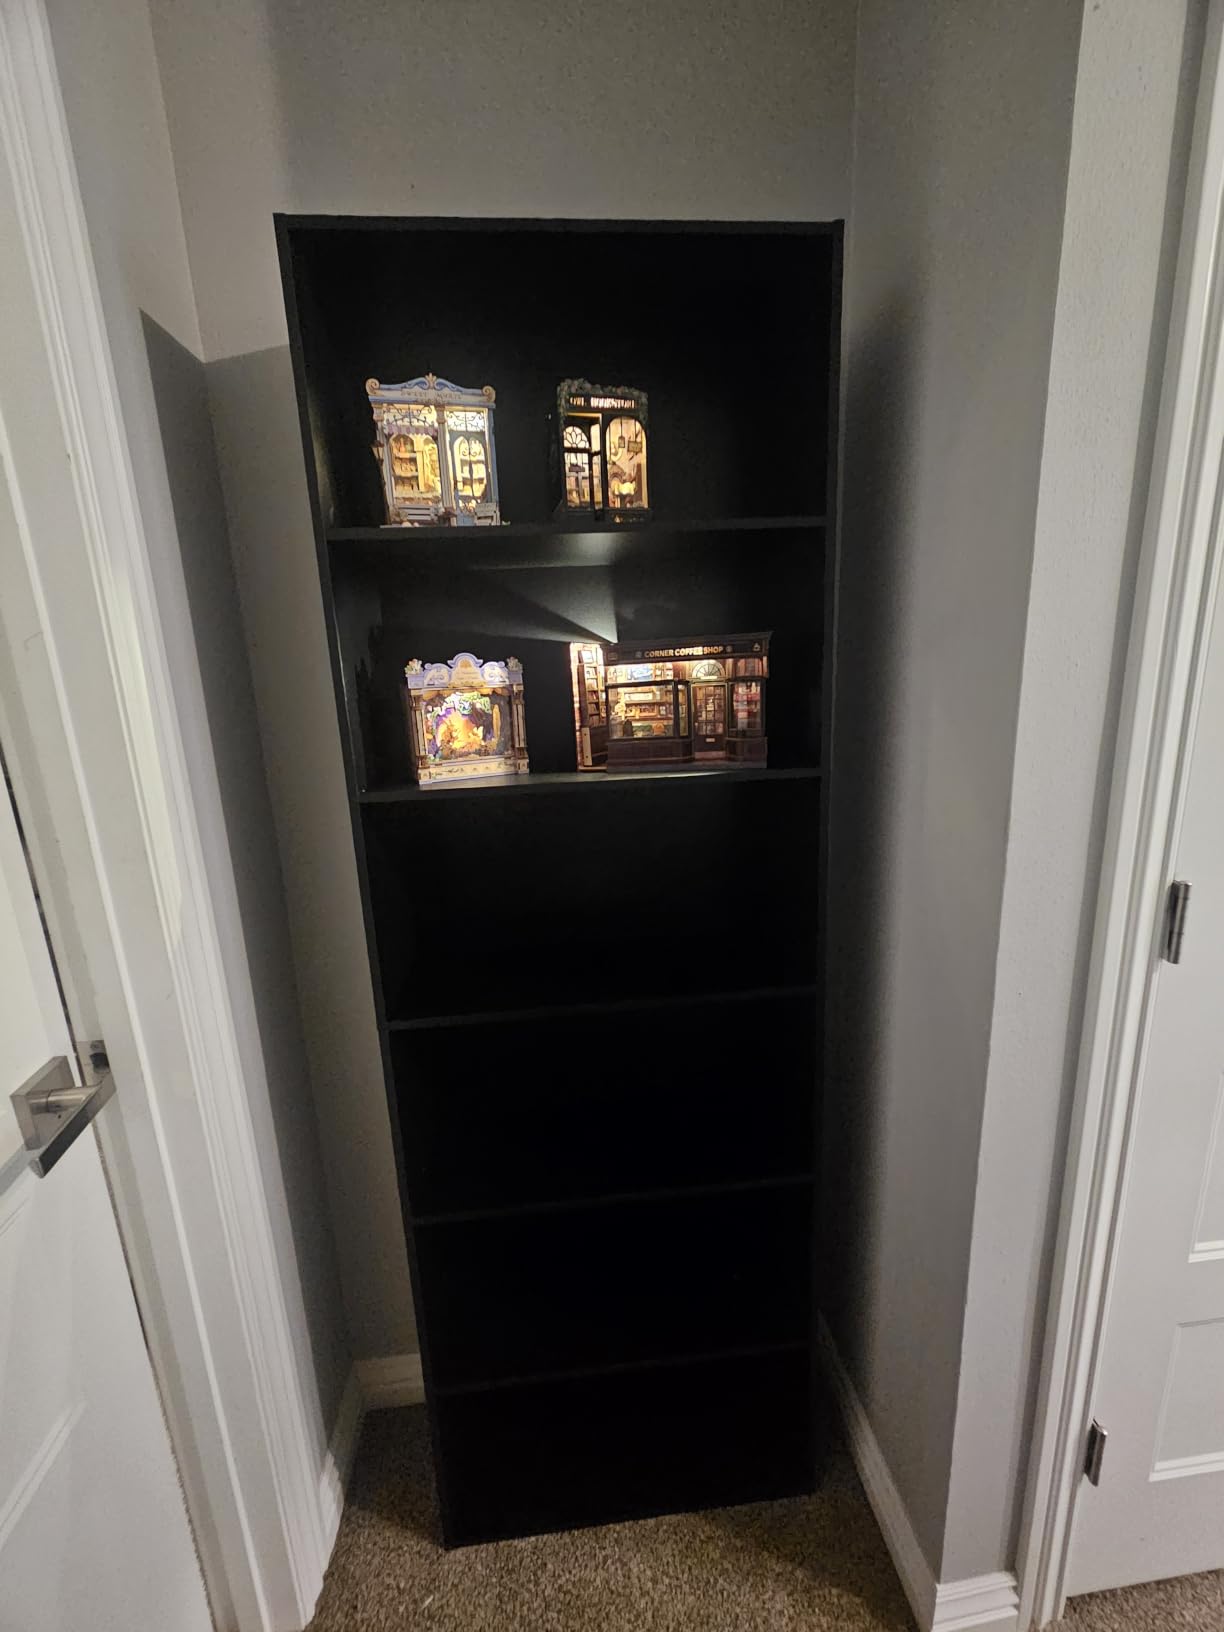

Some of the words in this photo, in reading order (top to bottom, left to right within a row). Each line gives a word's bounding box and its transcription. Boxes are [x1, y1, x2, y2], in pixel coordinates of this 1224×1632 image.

[644, 649, 674, 658] CORNER
[675, 646, 703, 657] COFFEE
[703, 646, 723, 654] SHOP
